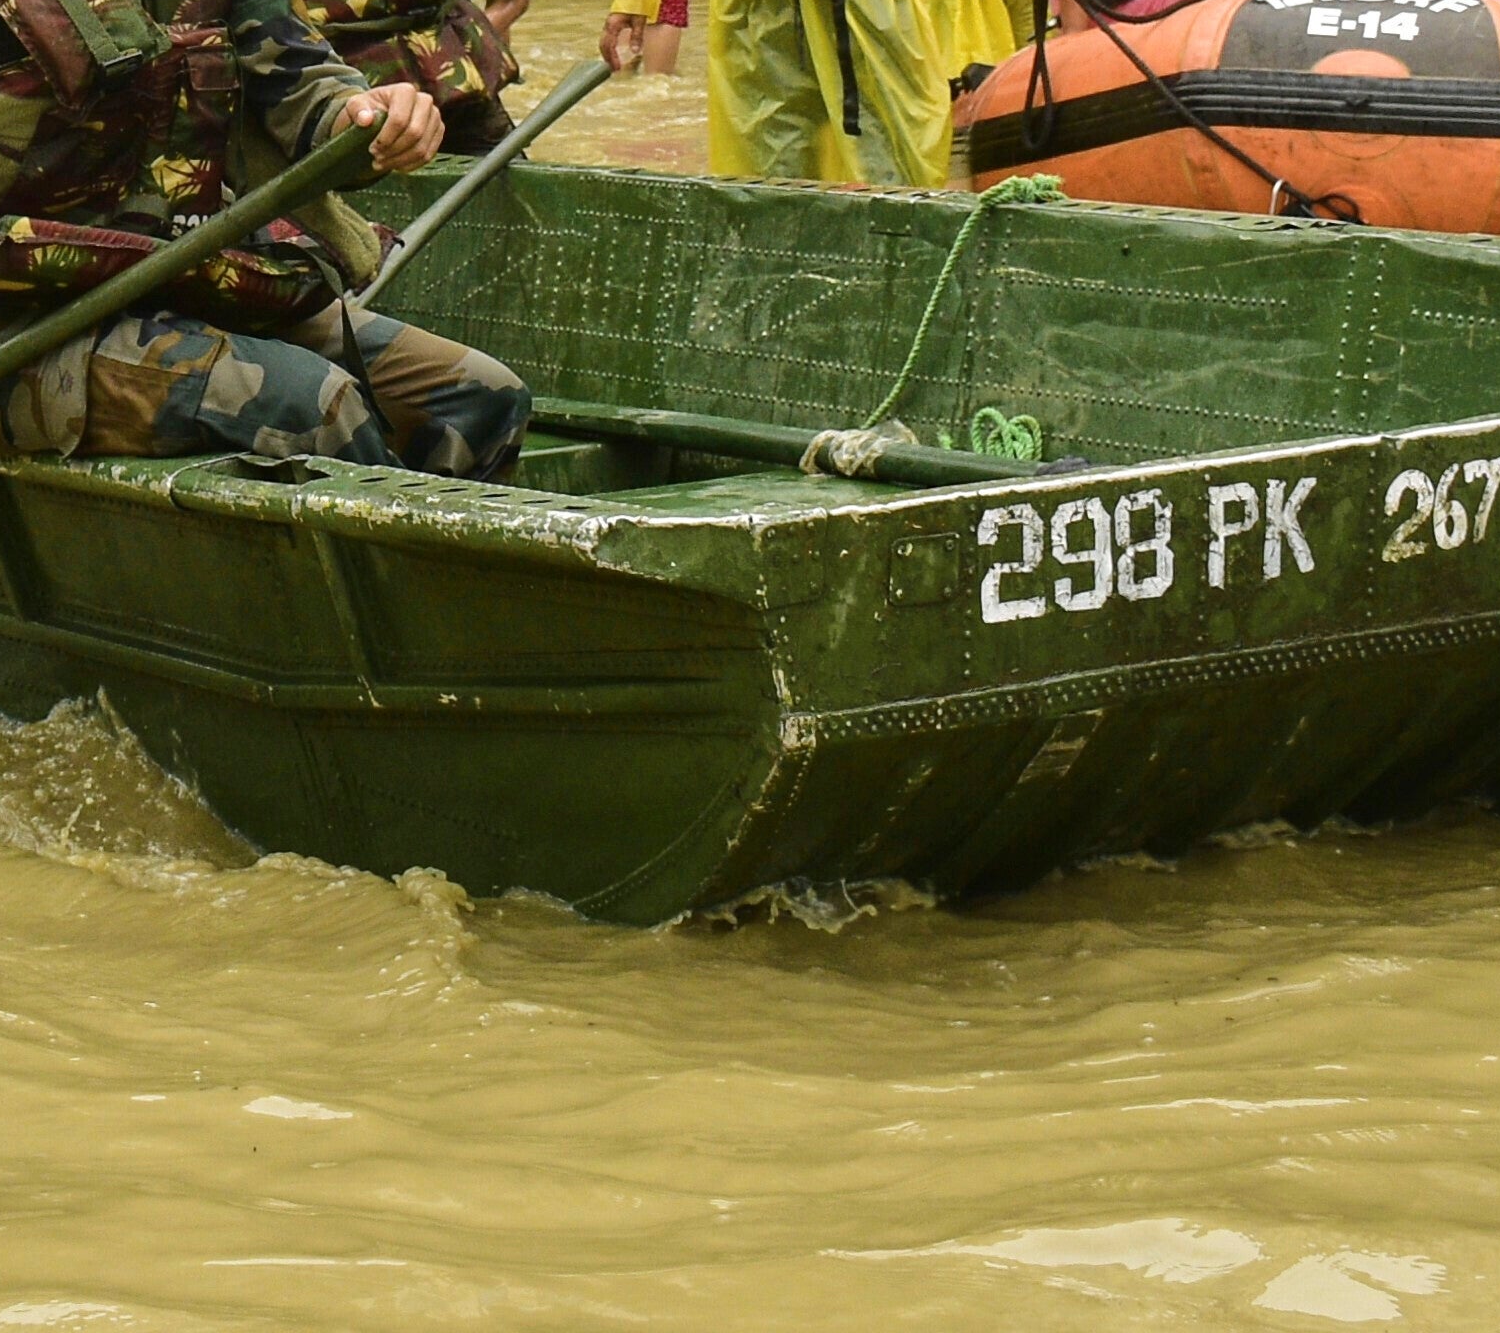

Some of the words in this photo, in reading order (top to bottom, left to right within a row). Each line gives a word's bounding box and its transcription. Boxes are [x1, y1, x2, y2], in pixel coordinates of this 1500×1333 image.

[1306, 6, 1420, 41] E-14
[976, 487, 1175, 624] 298
[1206, 476, 1318, 590] PK
